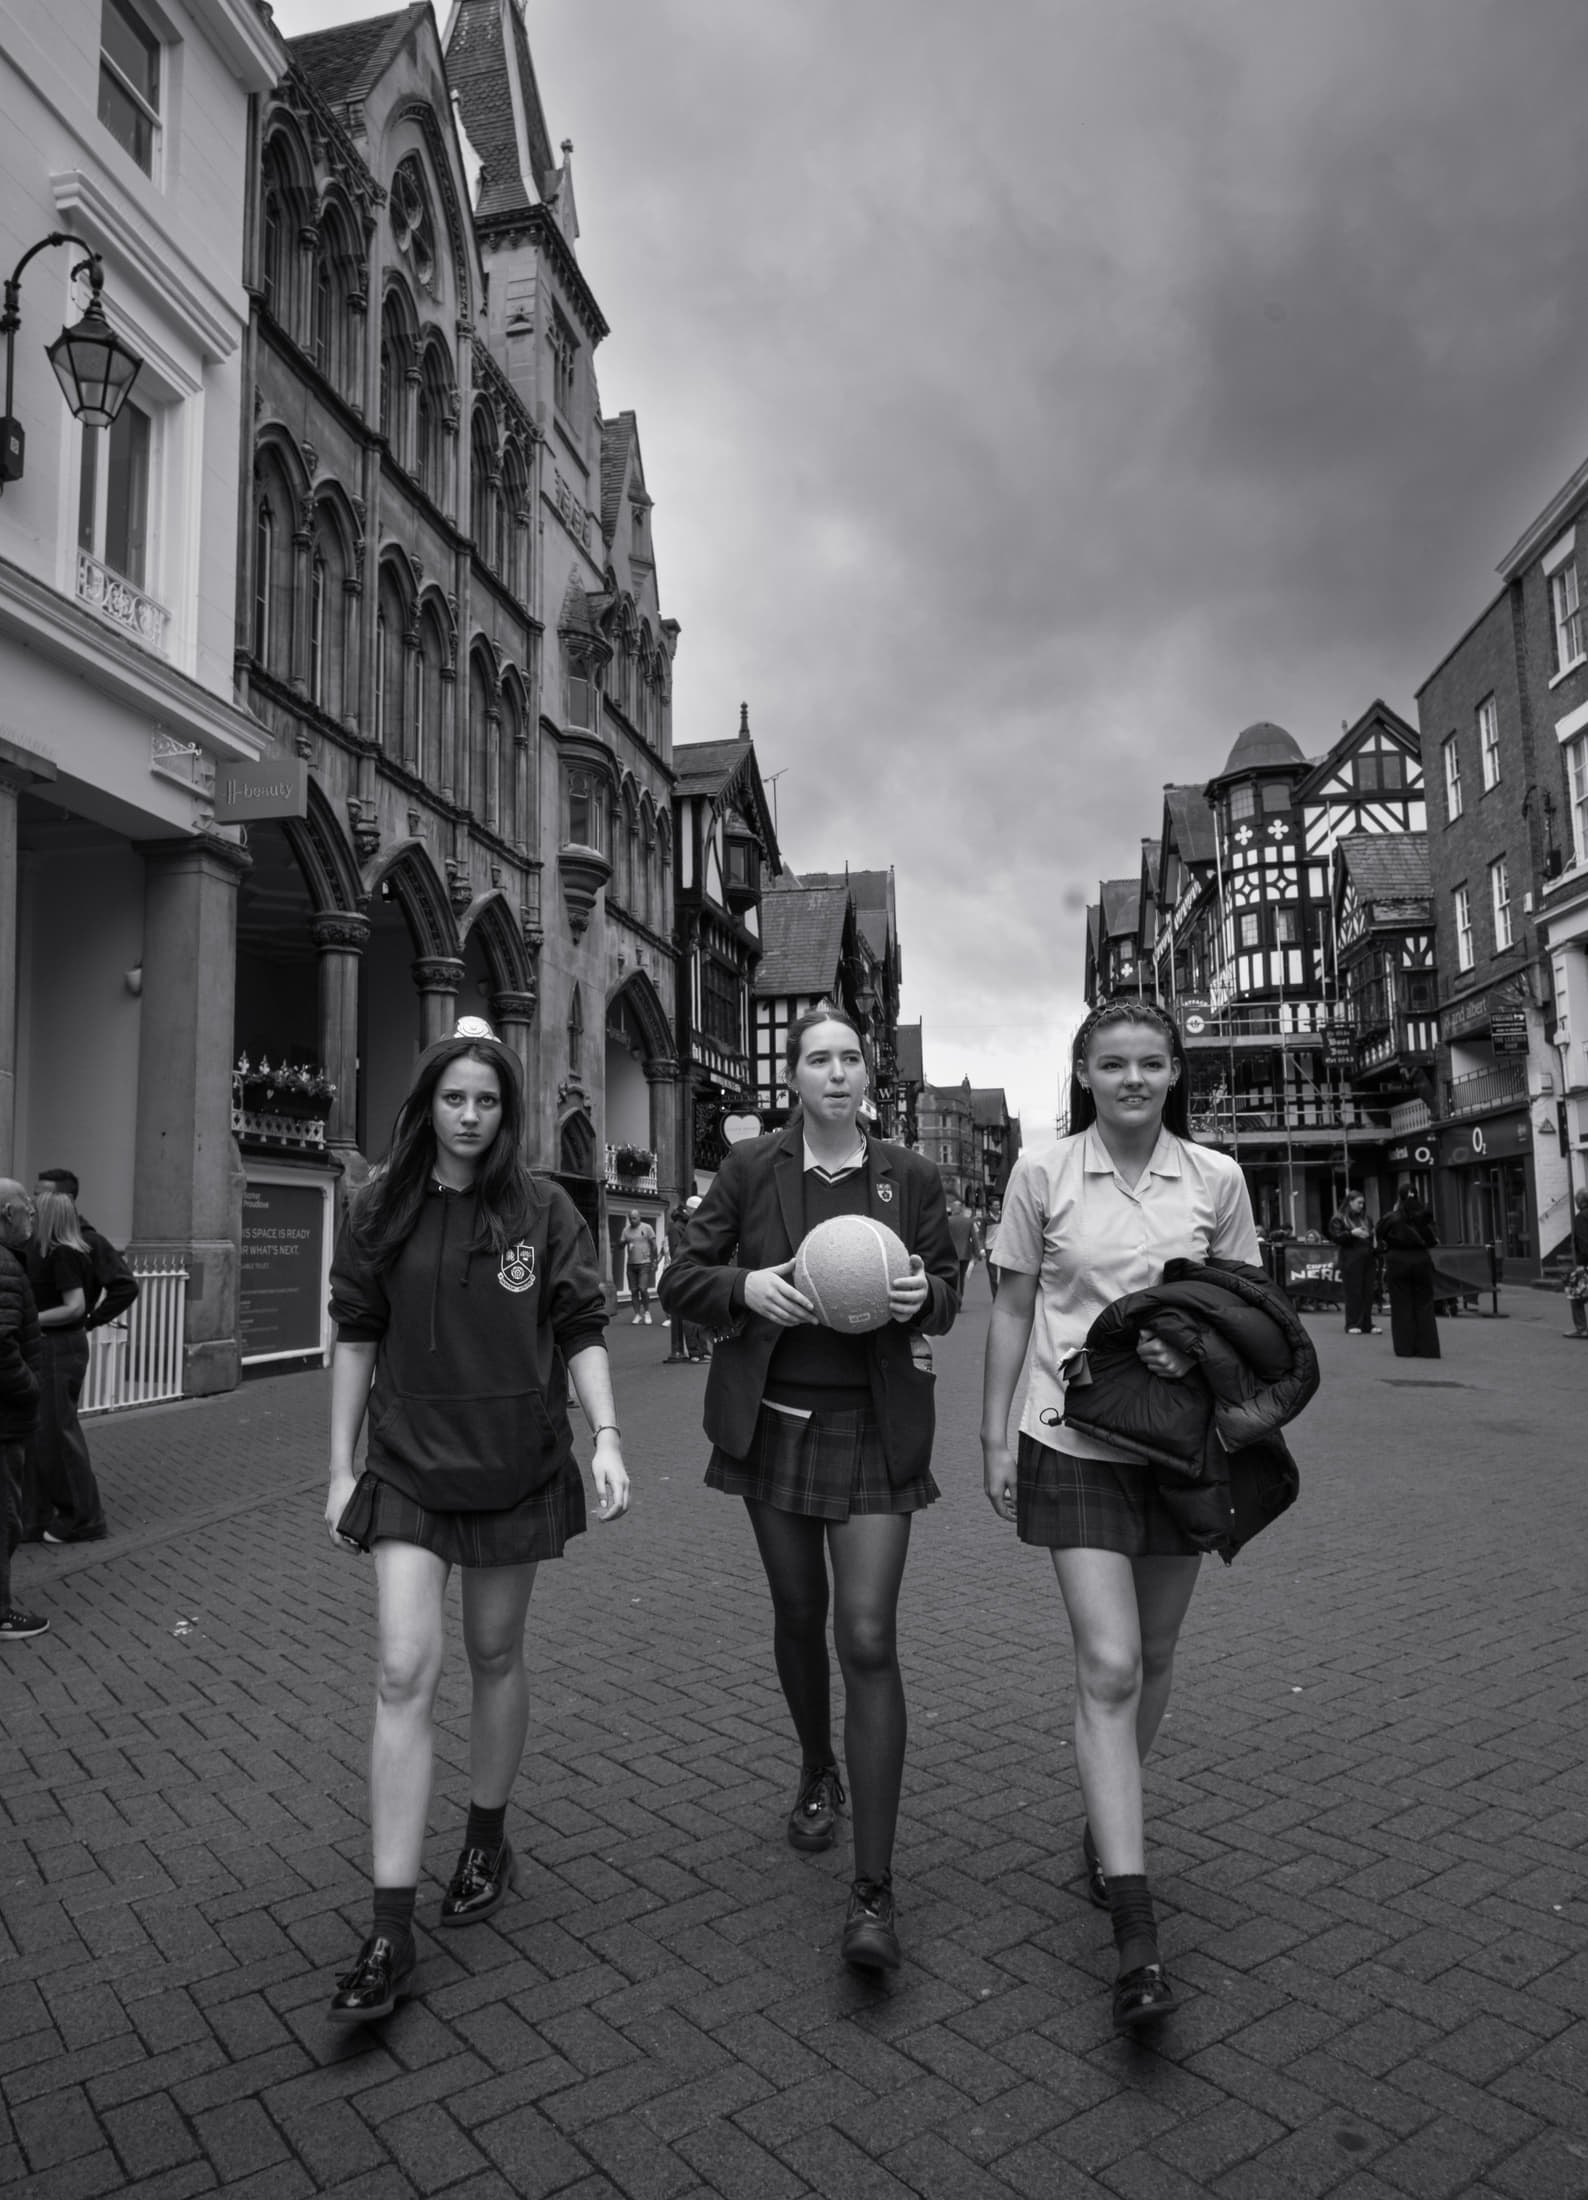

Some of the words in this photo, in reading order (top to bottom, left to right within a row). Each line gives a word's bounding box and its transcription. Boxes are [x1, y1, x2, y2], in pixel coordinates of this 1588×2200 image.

[243, 782, 294, 799] beauty
[251, 1228, 277, 1239] SPACE
[278, 1228, 286, 1239] IS
[286, 1228, 311, 1239] READY
[249, 1244, 278, 1256] WHAT'S
